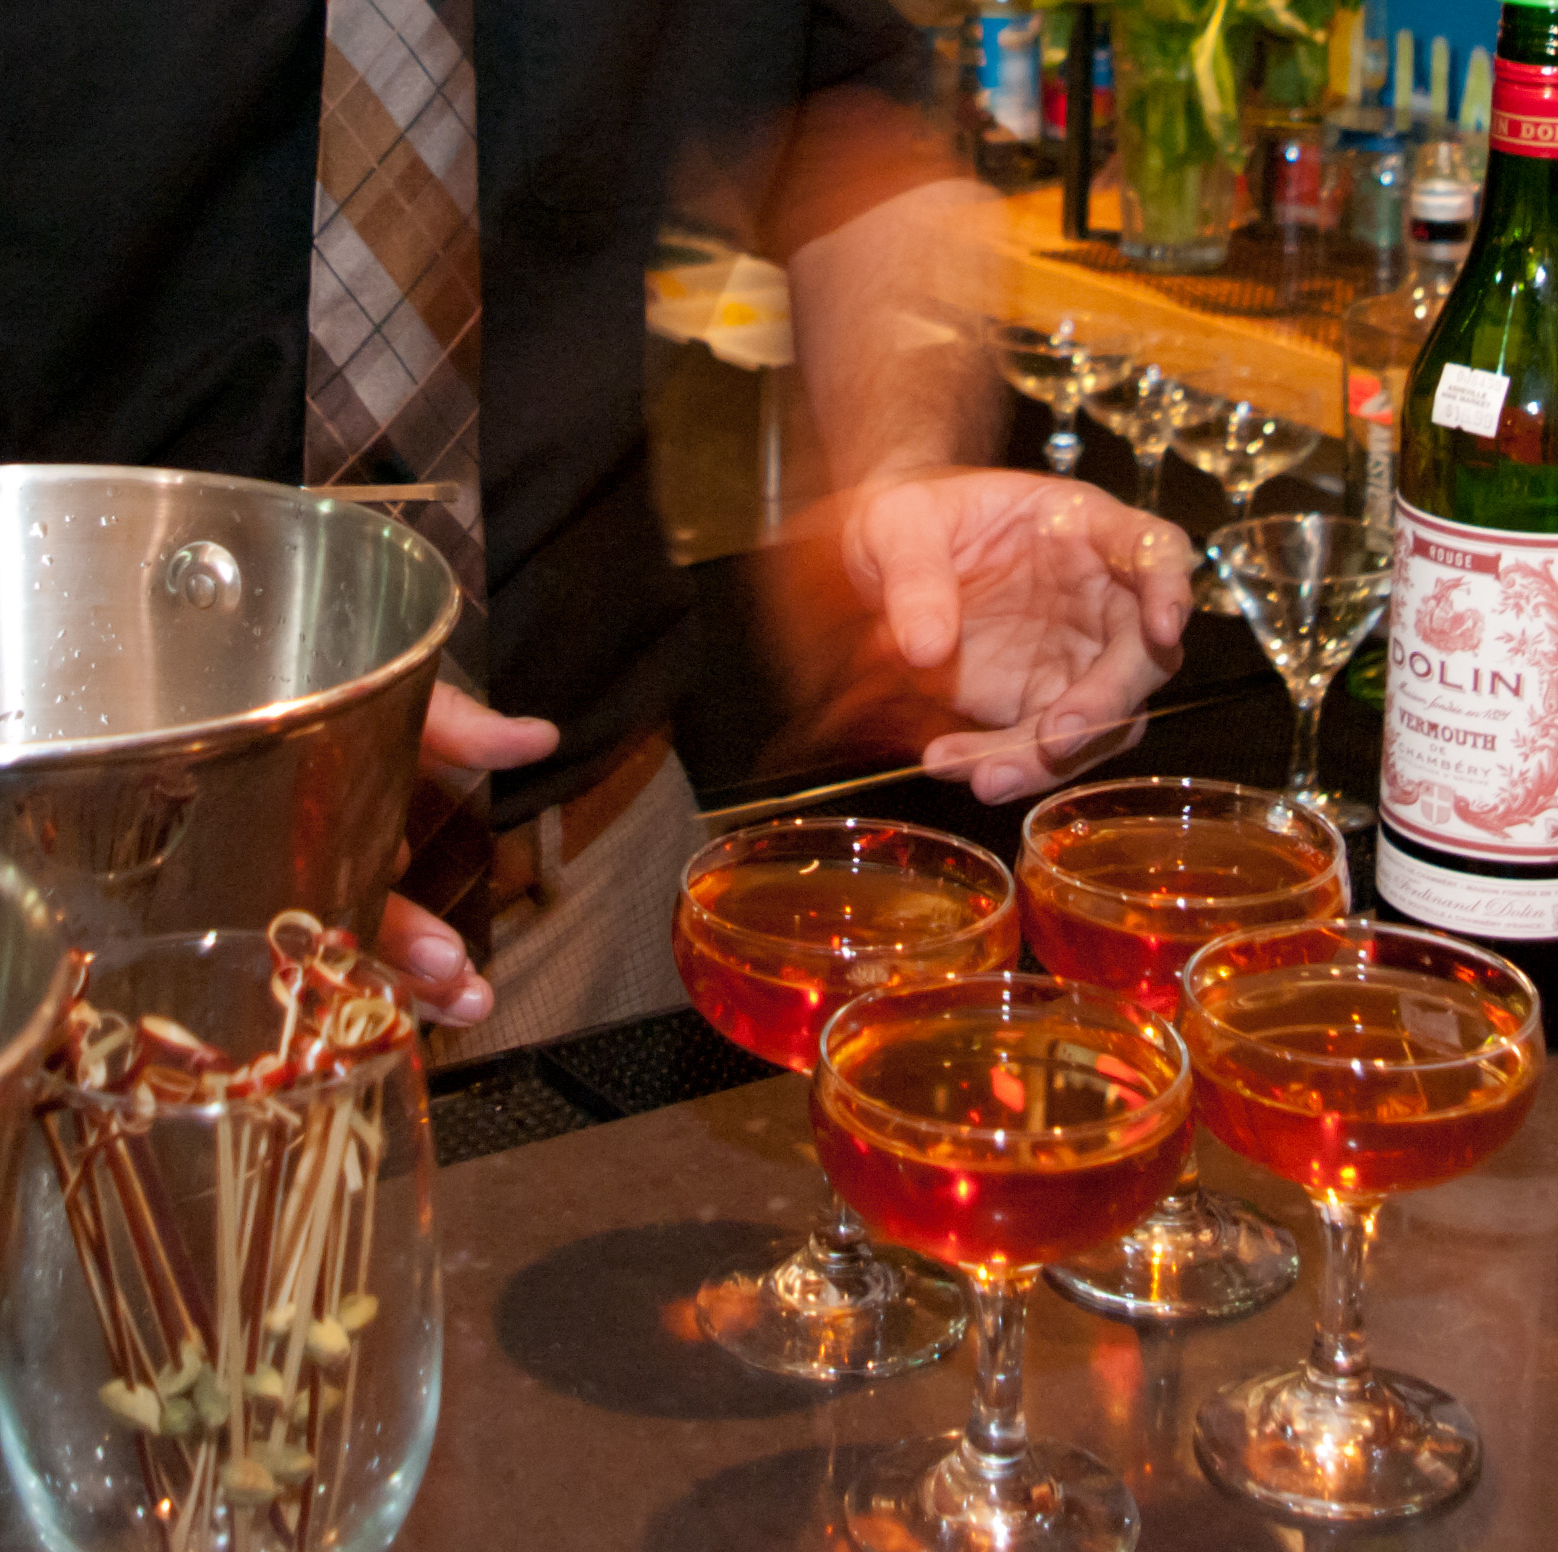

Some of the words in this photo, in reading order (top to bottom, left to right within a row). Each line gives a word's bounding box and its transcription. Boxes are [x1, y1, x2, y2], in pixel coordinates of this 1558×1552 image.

[1428, 544, 1473, 569] ROUGE
[1392, 636, 1524, 700] DOLIN
[1398, 705, 1498, 752] VERMOUTH
[1429, 742, 1447, 756] DE
[1397, 741, 1492, 777] CHAMBÉRY
[1393, 874, 1483, 914] Ferdinand
[1483, 896, 1547, 920] Dolin
